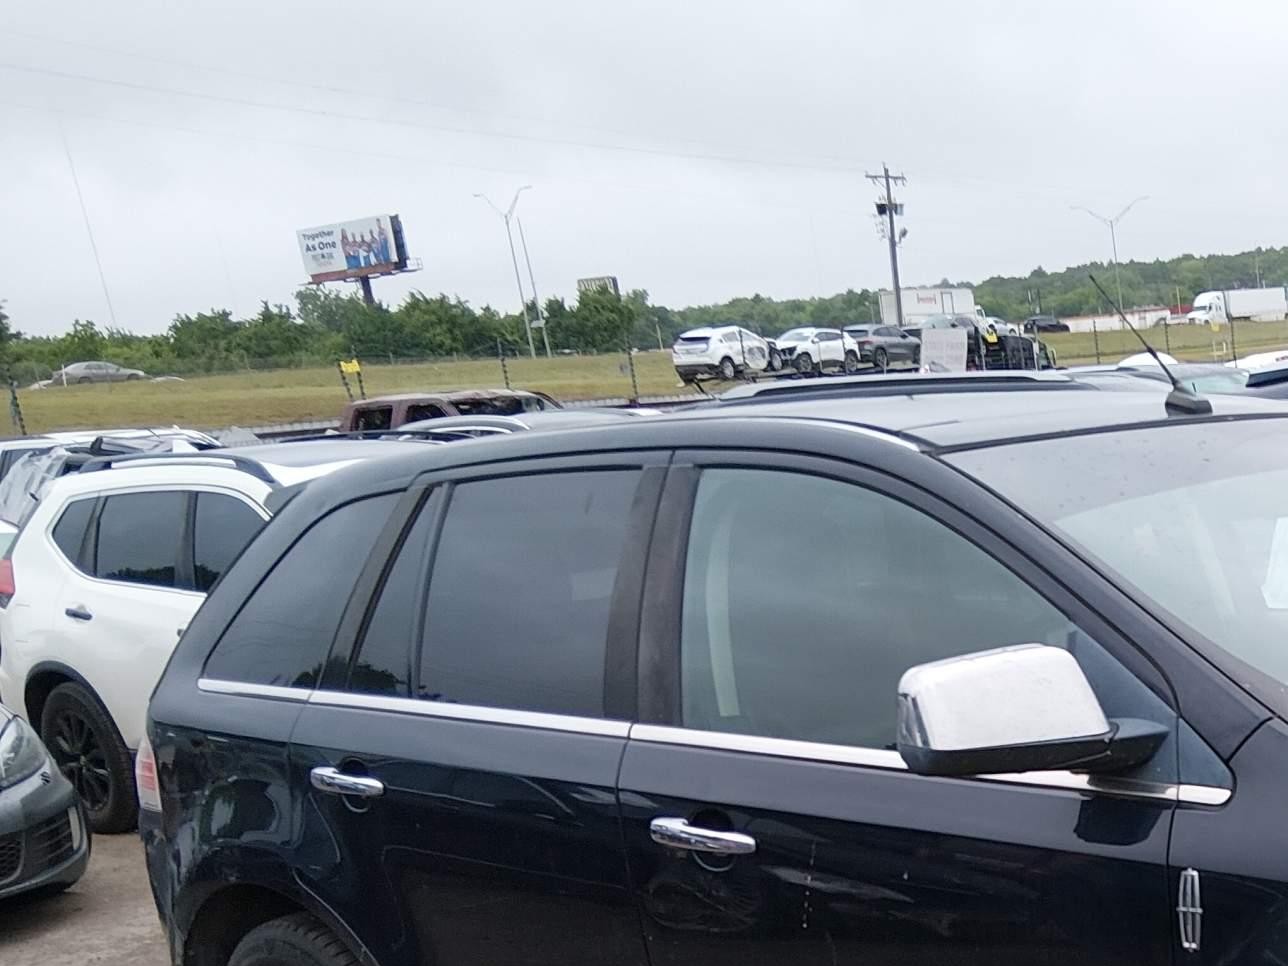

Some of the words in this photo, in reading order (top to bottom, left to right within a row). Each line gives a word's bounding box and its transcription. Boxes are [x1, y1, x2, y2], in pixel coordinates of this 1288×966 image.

[302, 230, 334, 241] Together
[305, 243, 317, 253] As
[318, 240, 337, 251] One
